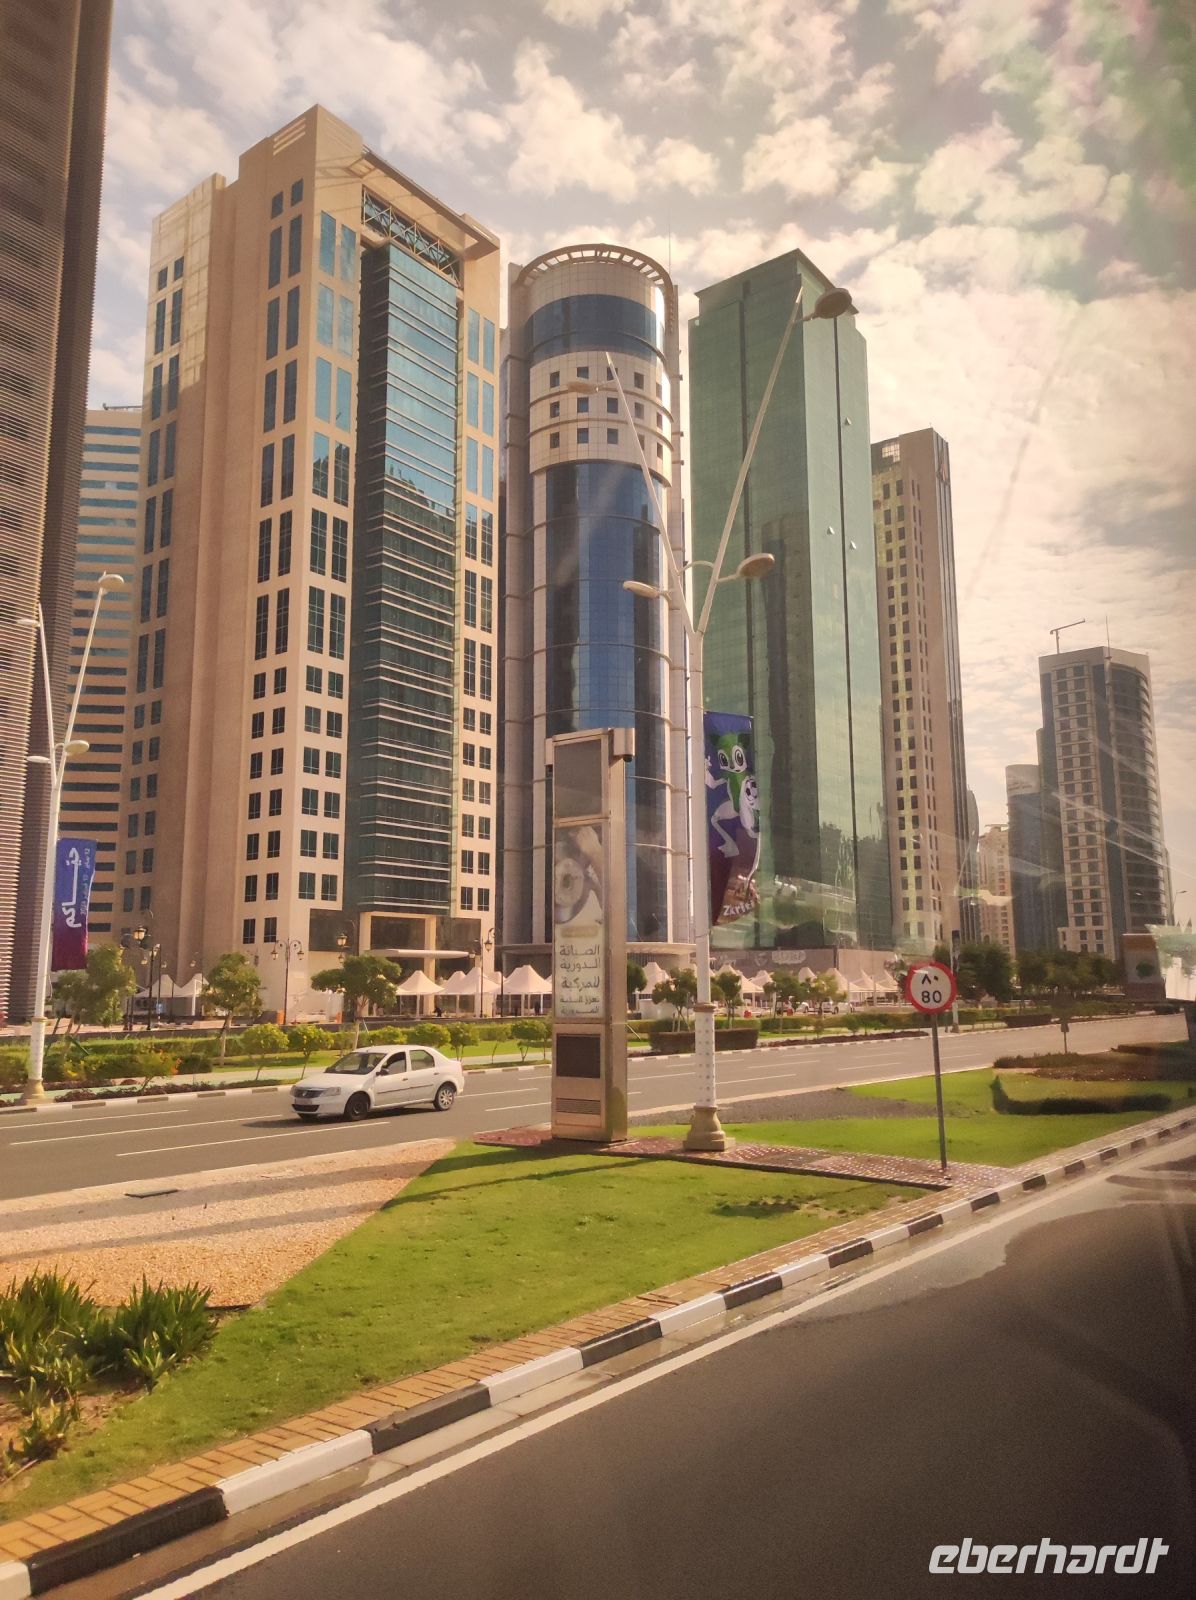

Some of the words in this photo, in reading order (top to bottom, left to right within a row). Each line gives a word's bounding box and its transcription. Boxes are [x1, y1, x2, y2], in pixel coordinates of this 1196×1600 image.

[559, 957, 601, 972] الدورية
[921, 973, 939, 985] ٨٠
[921, 990, 942, 1004] 80
